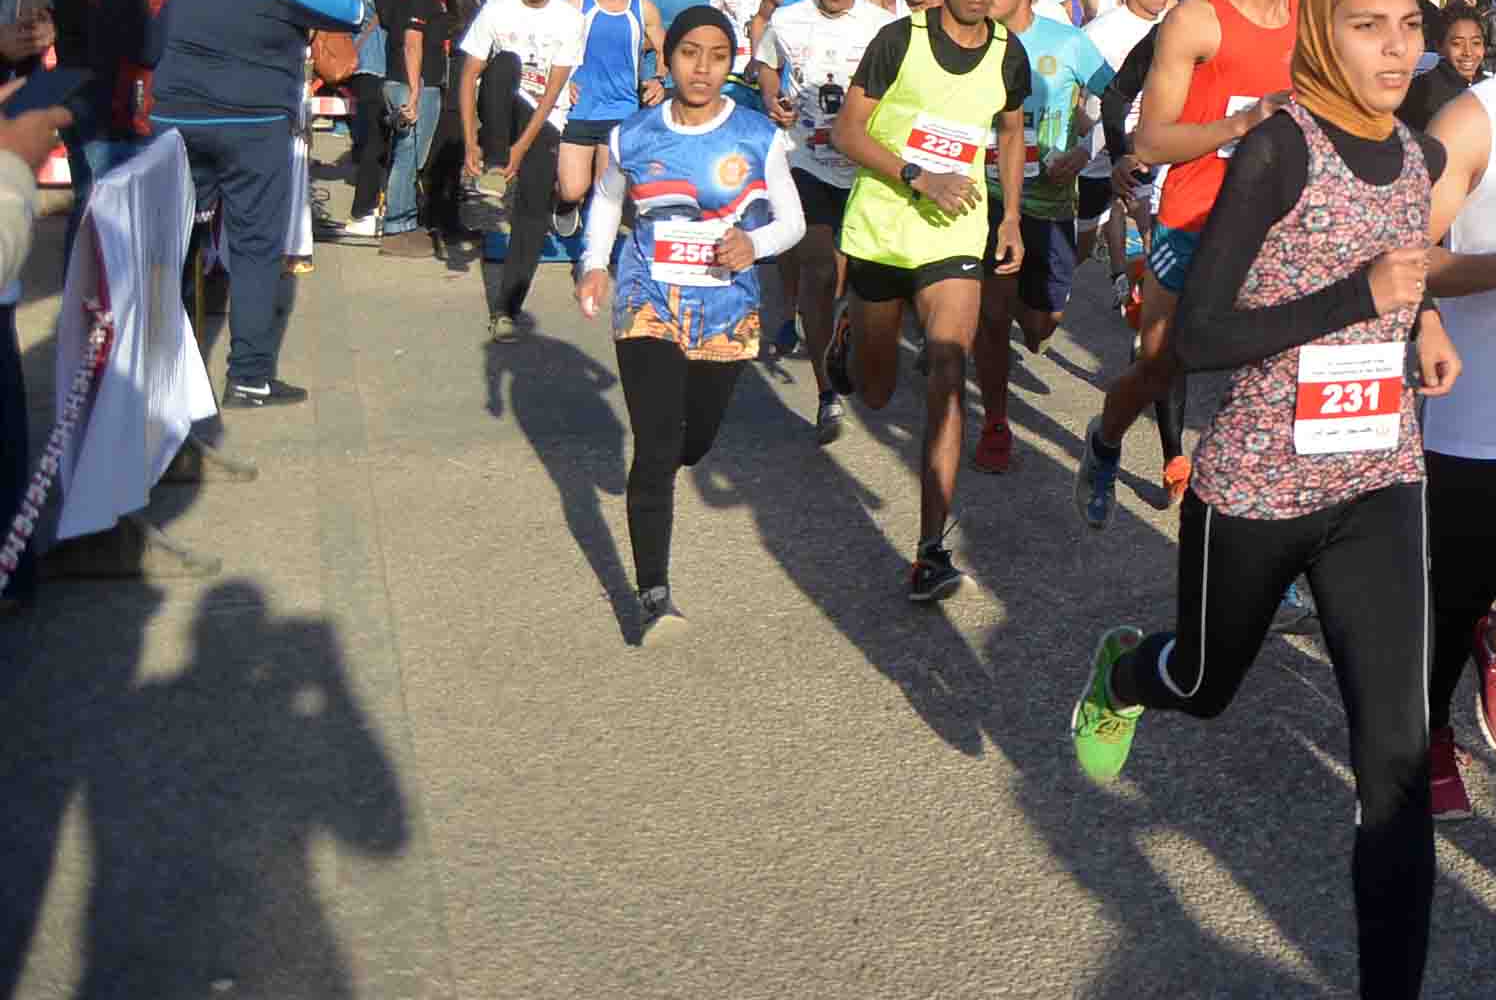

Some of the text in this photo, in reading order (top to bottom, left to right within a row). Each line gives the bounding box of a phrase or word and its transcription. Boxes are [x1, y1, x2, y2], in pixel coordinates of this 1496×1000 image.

[920, 134, 964, 158] 229
[669, 243, 715, 263] 256
[1320, 381, 1380, 415] 231
